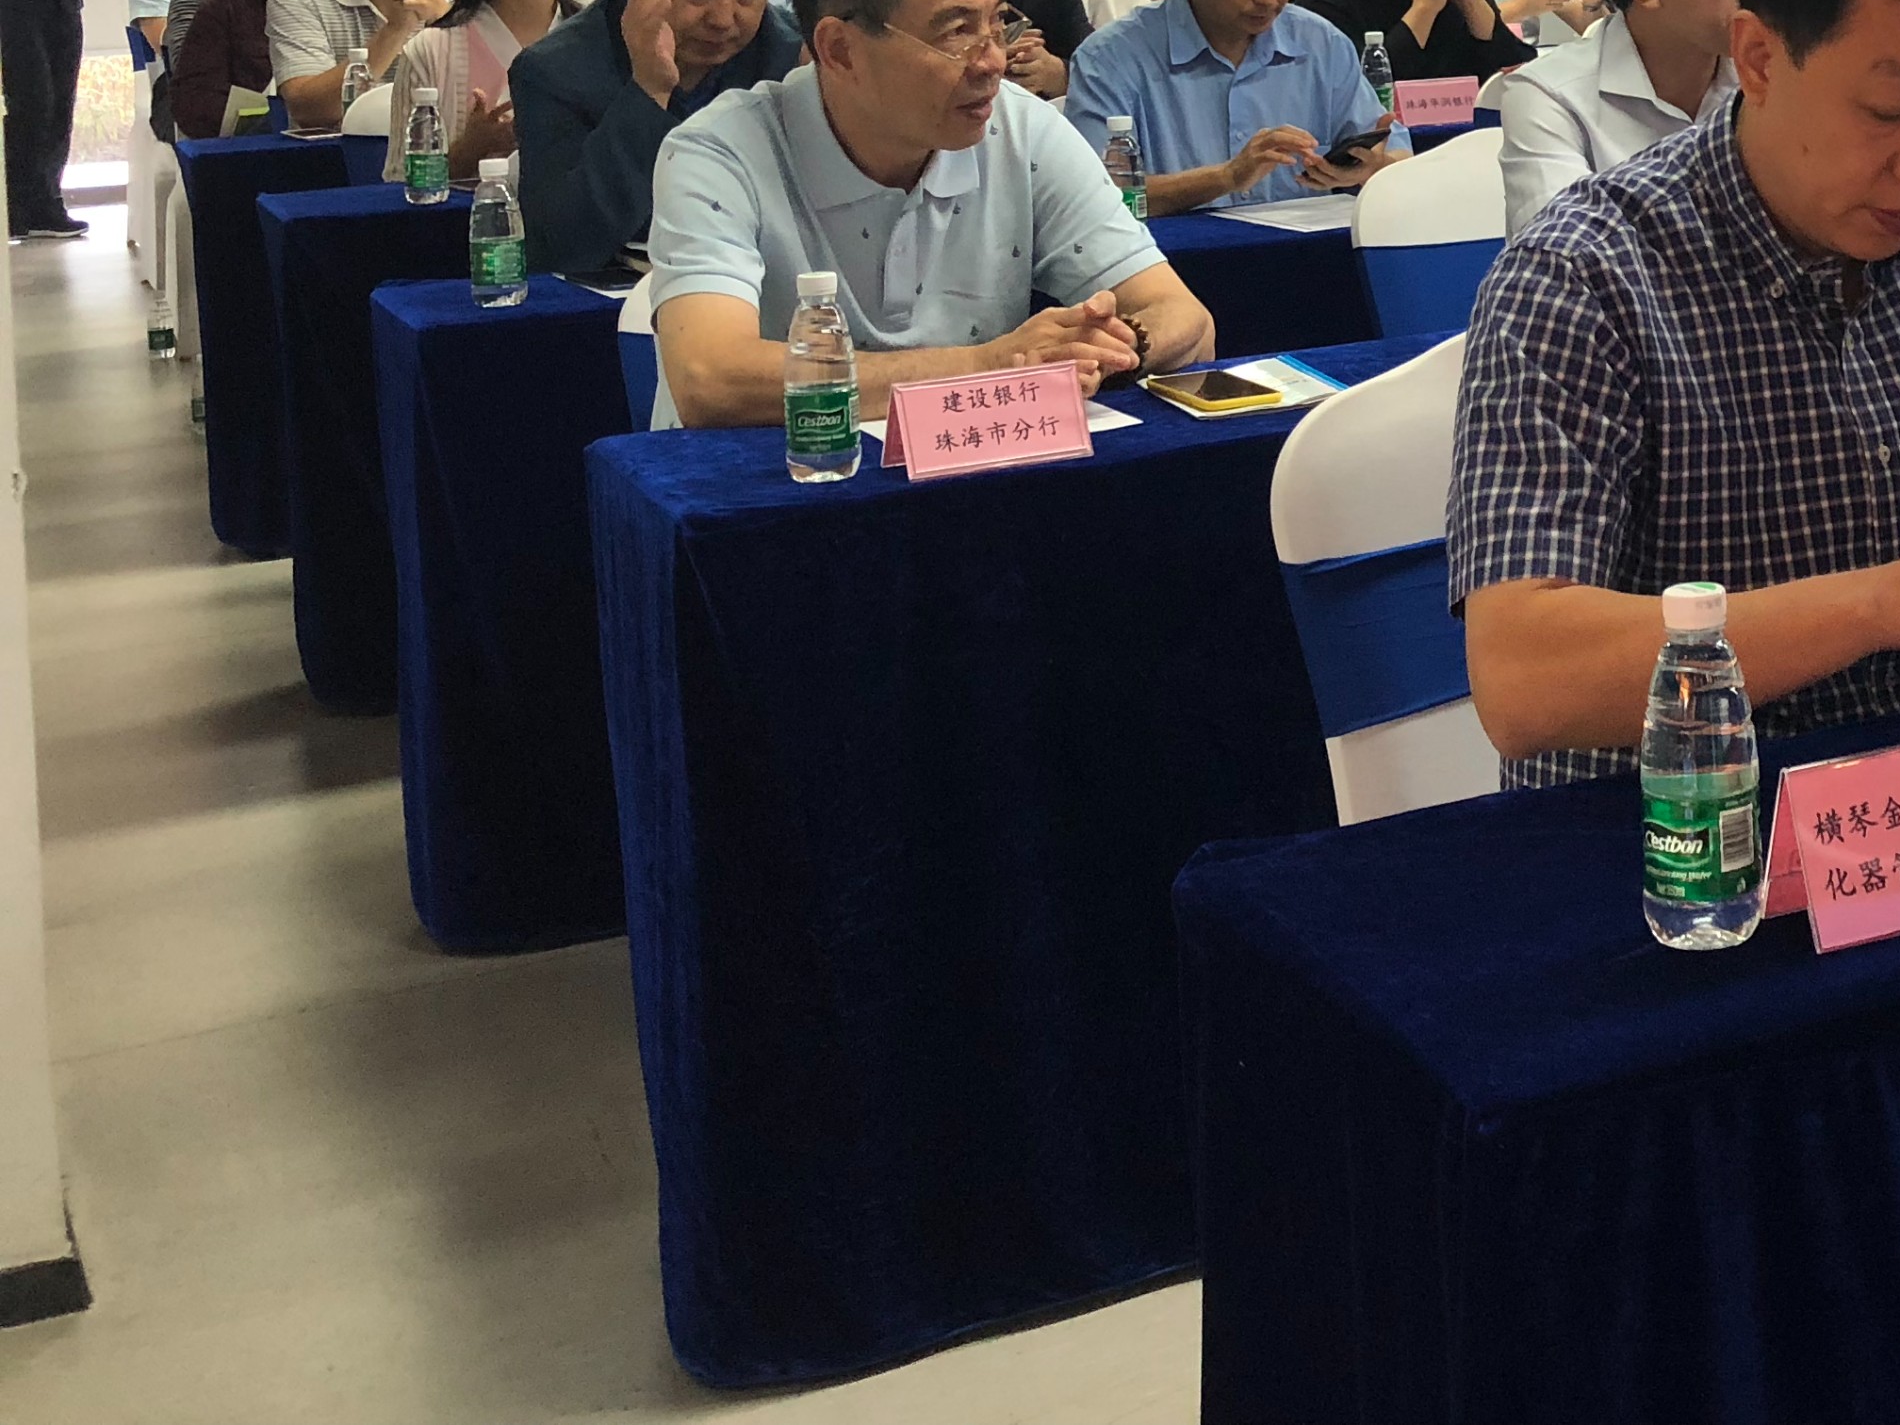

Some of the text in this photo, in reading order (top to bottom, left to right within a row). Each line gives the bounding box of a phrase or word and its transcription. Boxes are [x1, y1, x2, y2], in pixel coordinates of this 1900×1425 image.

[942, 381, 1040, 414] 建设银行
[935, 415, 1060, 453] 珠海市分行
